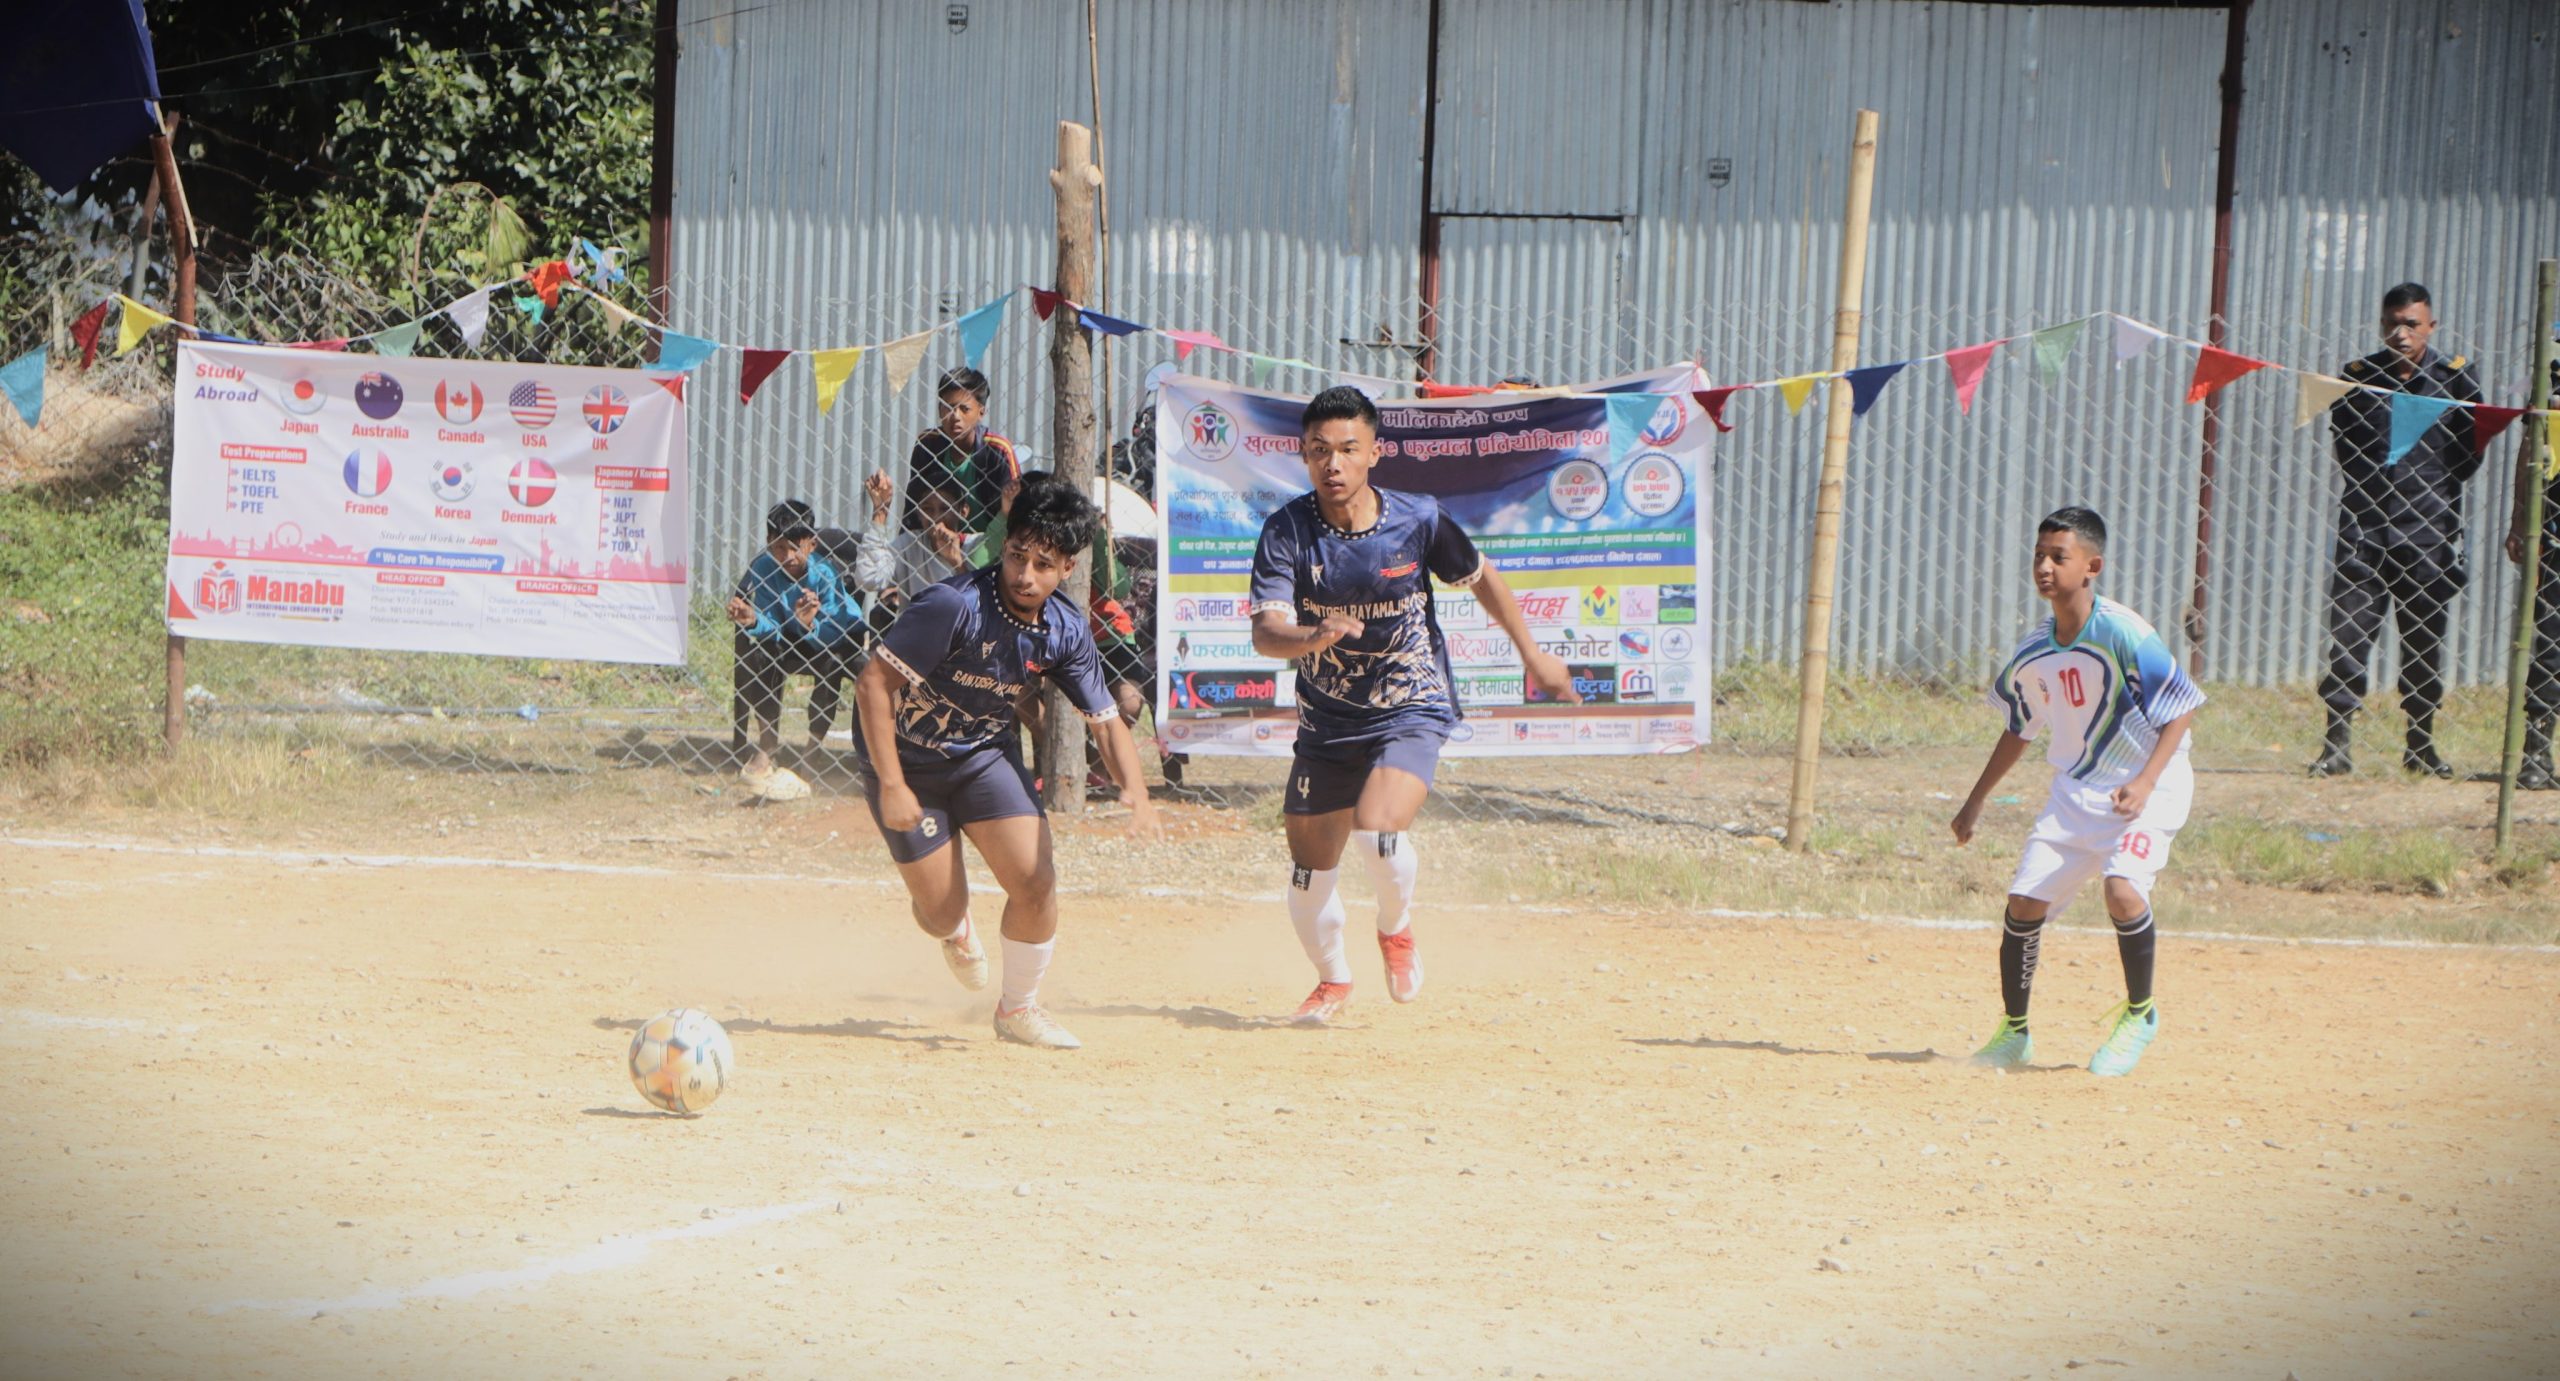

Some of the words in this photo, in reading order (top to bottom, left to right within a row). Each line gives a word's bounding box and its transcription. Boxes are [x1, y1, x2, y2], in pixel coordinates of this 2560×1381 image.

[195, 363, 246, 383] Study
[194, 385, 260, 403] Abroad
[280, 419, 319, 435] Japan
[352, 423, 409, 440] Australia
[438, 428, 485, 443] Canada
[522, 433, 547, 448] USA
[592, 438, 608, 451] UK
[223, 446, 243, 458] Test
[244, 447, 305, 461] Preparations
[242, 468, 276, 483] IELTS
[242, 484, 279, 499] TOEFL
[240, 501, 264, 514] PTE
[345, 500, 389, 516] France
[613, 497, 634, 509] NAT
[435, 505, 471, 520] Korea
[501, 510, 557, 525] Denmark
[613, 512, 637, 524] JLPT
[612, 527, 645, 539] J-Test
[469, 536, 498, 547] Japan
[381, 573, 406, 583] HEAD
[247, 575, 344, 607] Manabu
[520, 581, 559, 592] BRANCH
[953, 669, 996, 691] SANTOSH
[2058, 667, 2086, 708] 10
[1297, 776, 1310, 799] 4
[920, 816, 938, 838] 8
[2119, 831, 2151, 860] 10
